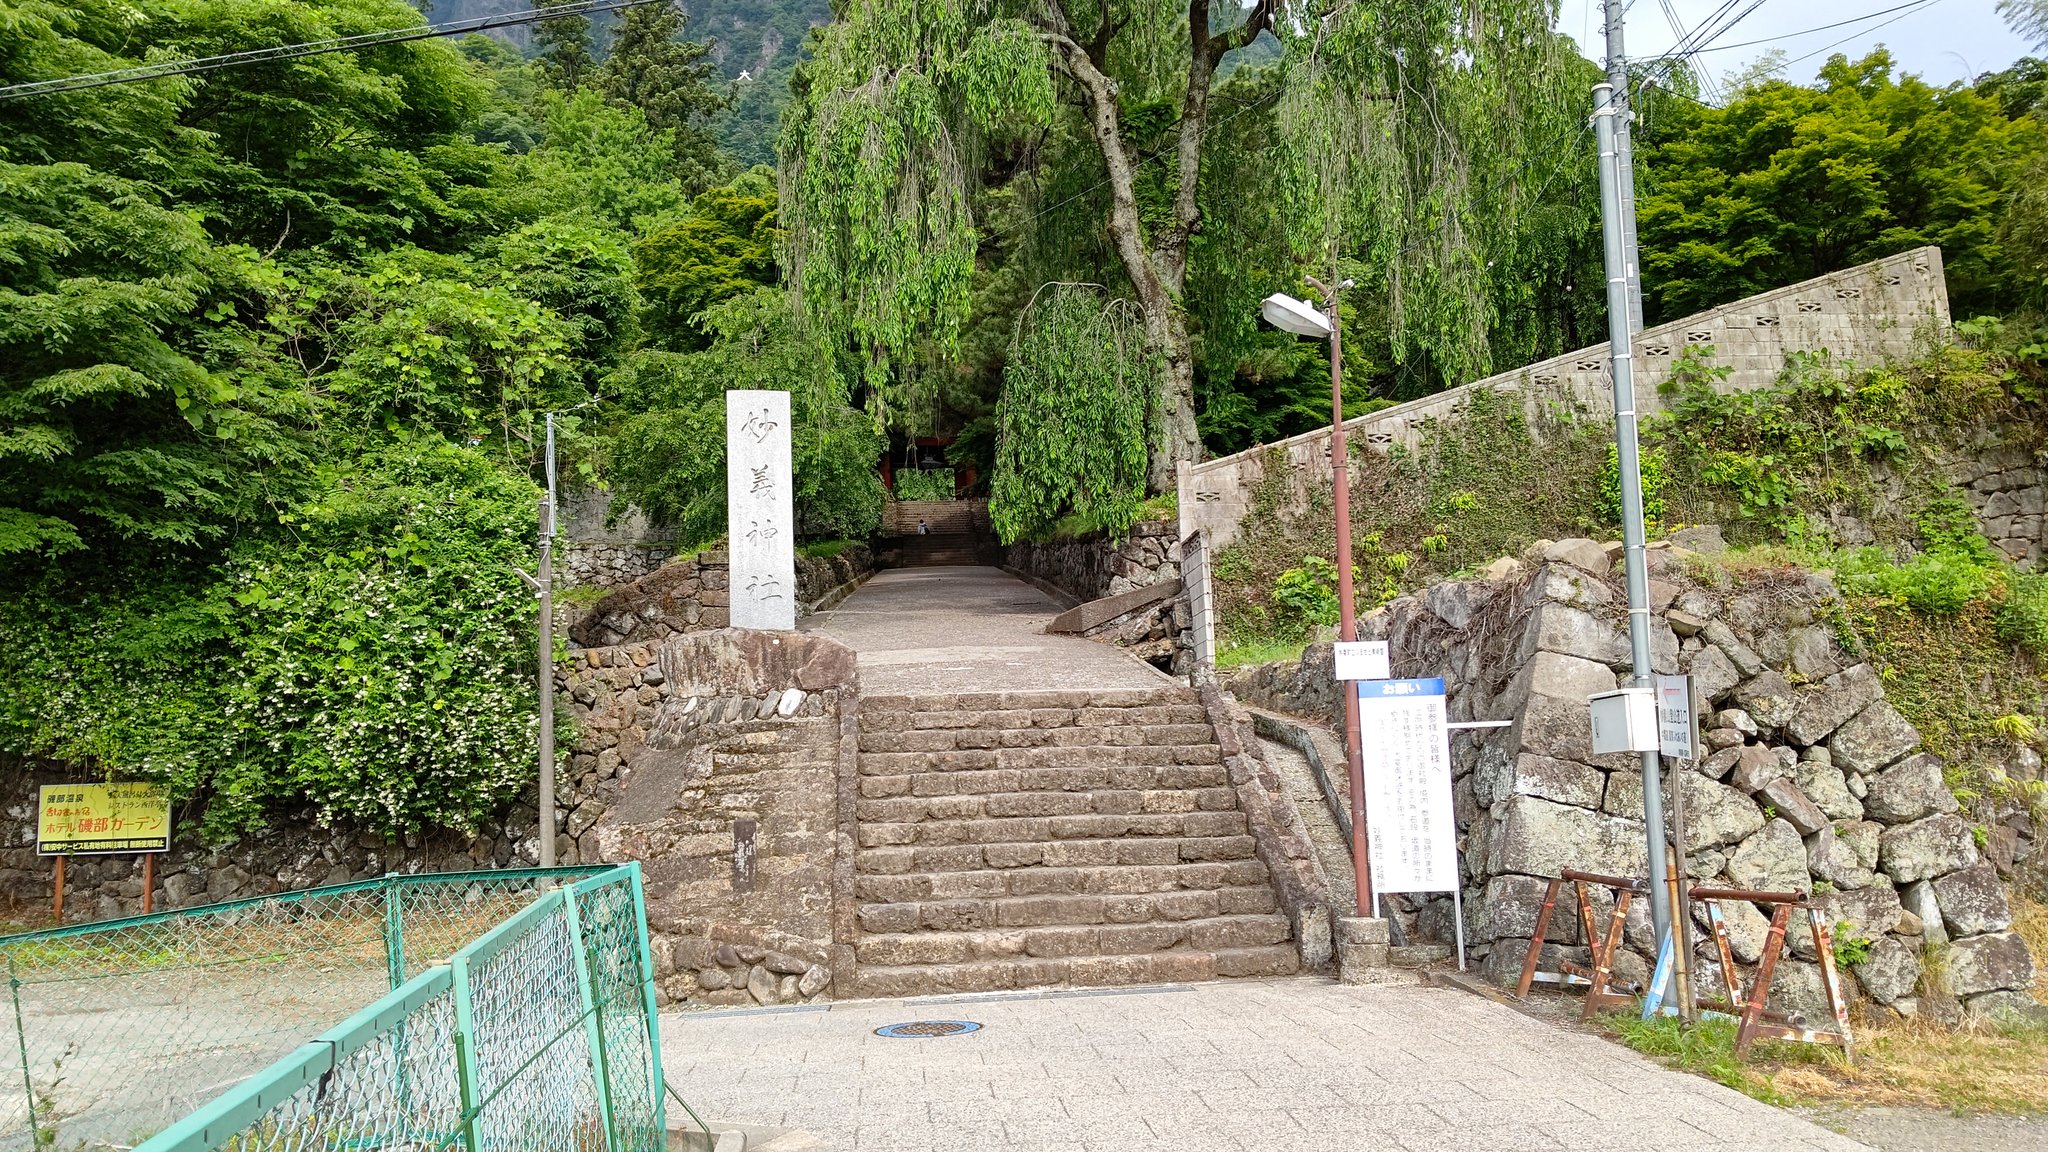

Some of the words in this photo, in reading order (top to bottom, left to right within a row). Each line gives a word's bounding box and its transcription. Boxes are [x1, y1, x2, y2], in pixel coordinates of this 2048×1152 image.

[741, 408, 783, 601] 妙義神社
[1383, 683, 1421, 695] お願い
[47, 793, 84, 804] 磯部温泉
